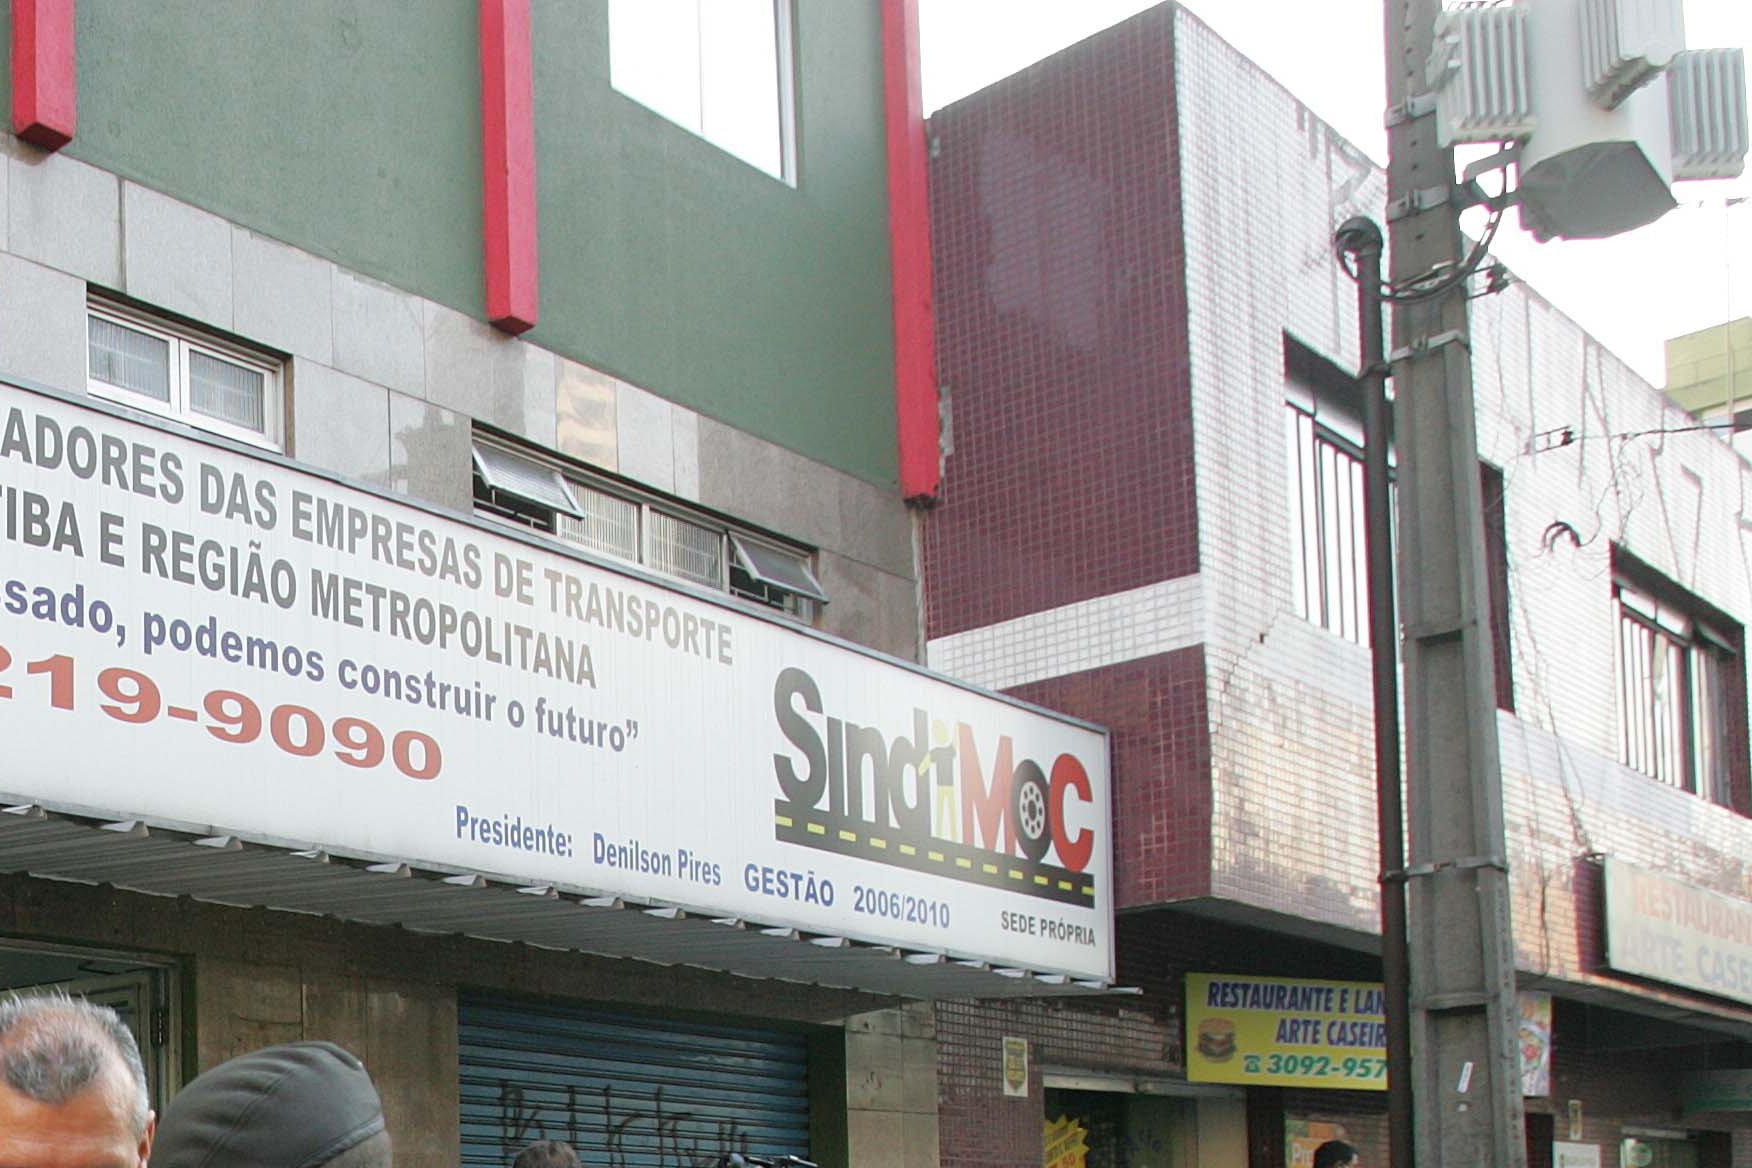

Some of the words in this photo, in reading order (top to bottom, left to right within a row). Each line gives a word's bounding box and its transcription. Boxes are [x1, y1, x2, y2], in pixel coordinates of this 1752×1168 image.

[200, 462, 277, 531] DAS
[292, 490, 482, 590] EMPRESAS
[494, 554, 534, 606] DE
[544, 570, 733, 666] TRANSPORTE
[100, 510, 125, 568] E
[142, 521, 296, 610] REGIÃO
[311, 568, 597, 690] METROPOLITANA
[144, 611, 324, 682] podemos
[338, 659, 497, 722] construir
[507, 699, 525, 728] o
[456, 805, 573, 858] Presidente:
[594, 832, 672, 877] Denilson
[678, 849, 721, 886] Pires
[744, 863, 834, 907] GESTÃO
[853, 885, 950, 928] 2006/2010
[1001, 910, 1036, 935] SEDE
[1040, 917, 1096, 947] PRÓPRIA
[1207, 981, 1333, 1013] RESTAURANTE
[1339, 988, 1348, 1013] E
[1353, 988, 1385, 1015] LAN
[1275, 1018, 1321, 1044] ARTE
[1327, 1020, 1386, 1047] CASEIR
[1267, 1054, 1387, 1078] 3092-957
